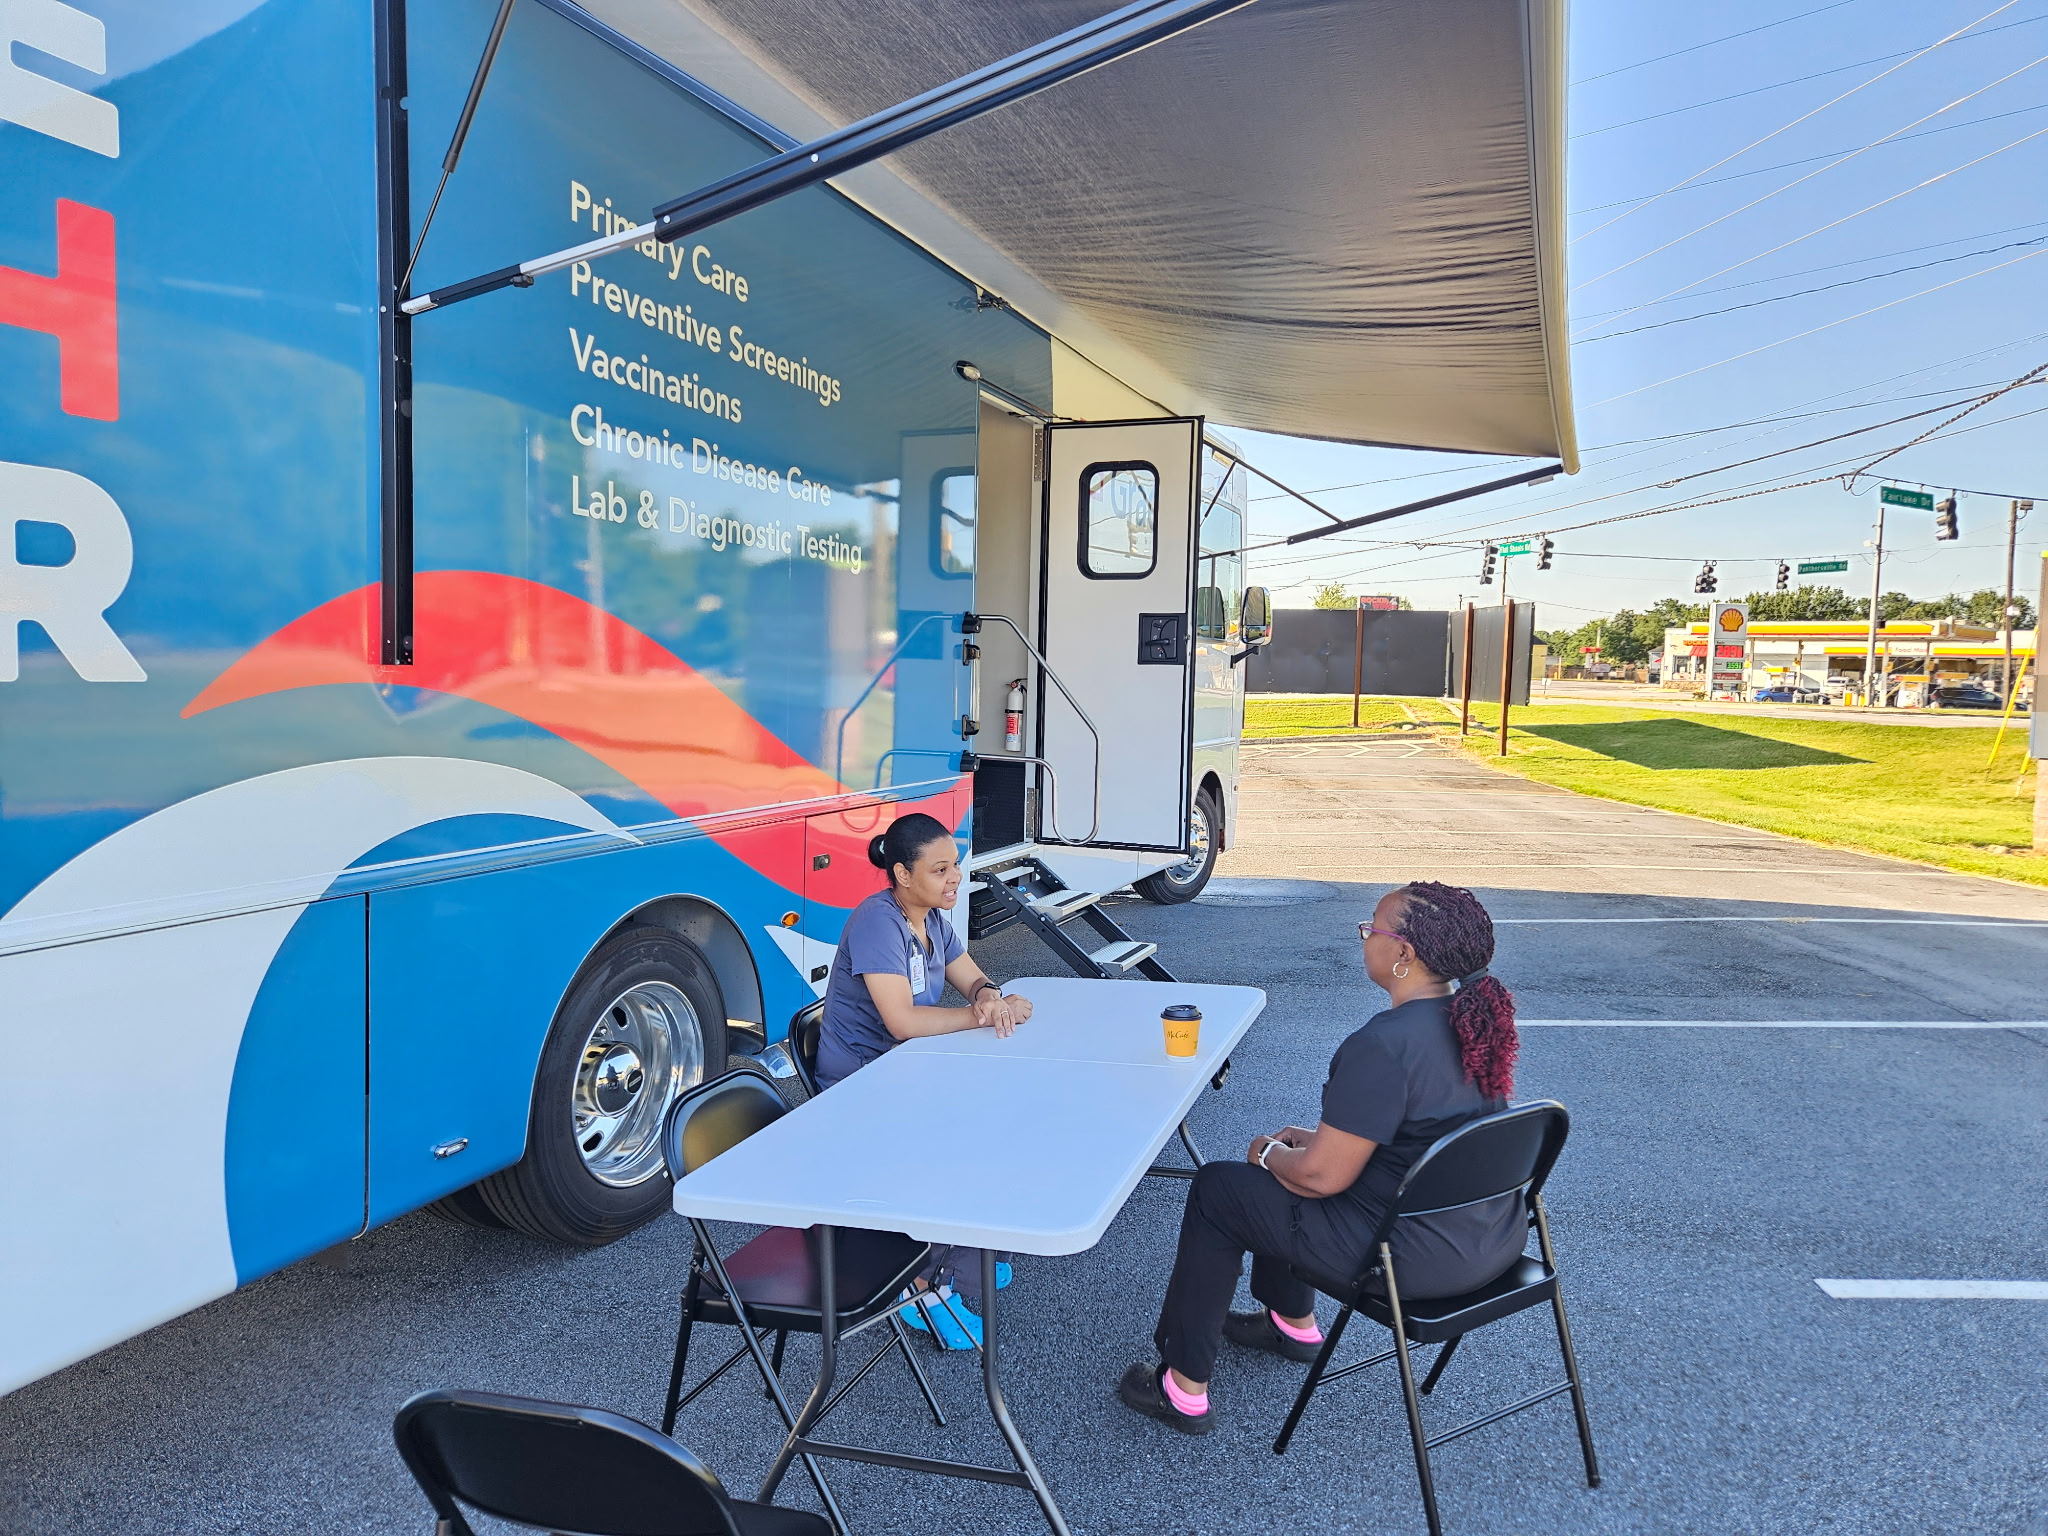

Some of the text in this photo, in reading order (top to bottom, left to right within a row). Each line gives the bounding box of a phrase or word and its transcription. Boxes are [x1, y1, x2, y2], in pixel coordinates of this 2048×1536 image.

[691, 244, 749, 302] Care
[568, 327, 742, 424] Vaccinations
[570, 260, 841, 407] Preventive Screenings
[570, 404, 832, 507] Chronic Disease Care
[571, 475, 863, 574] Lab & Diagnostic Testing
